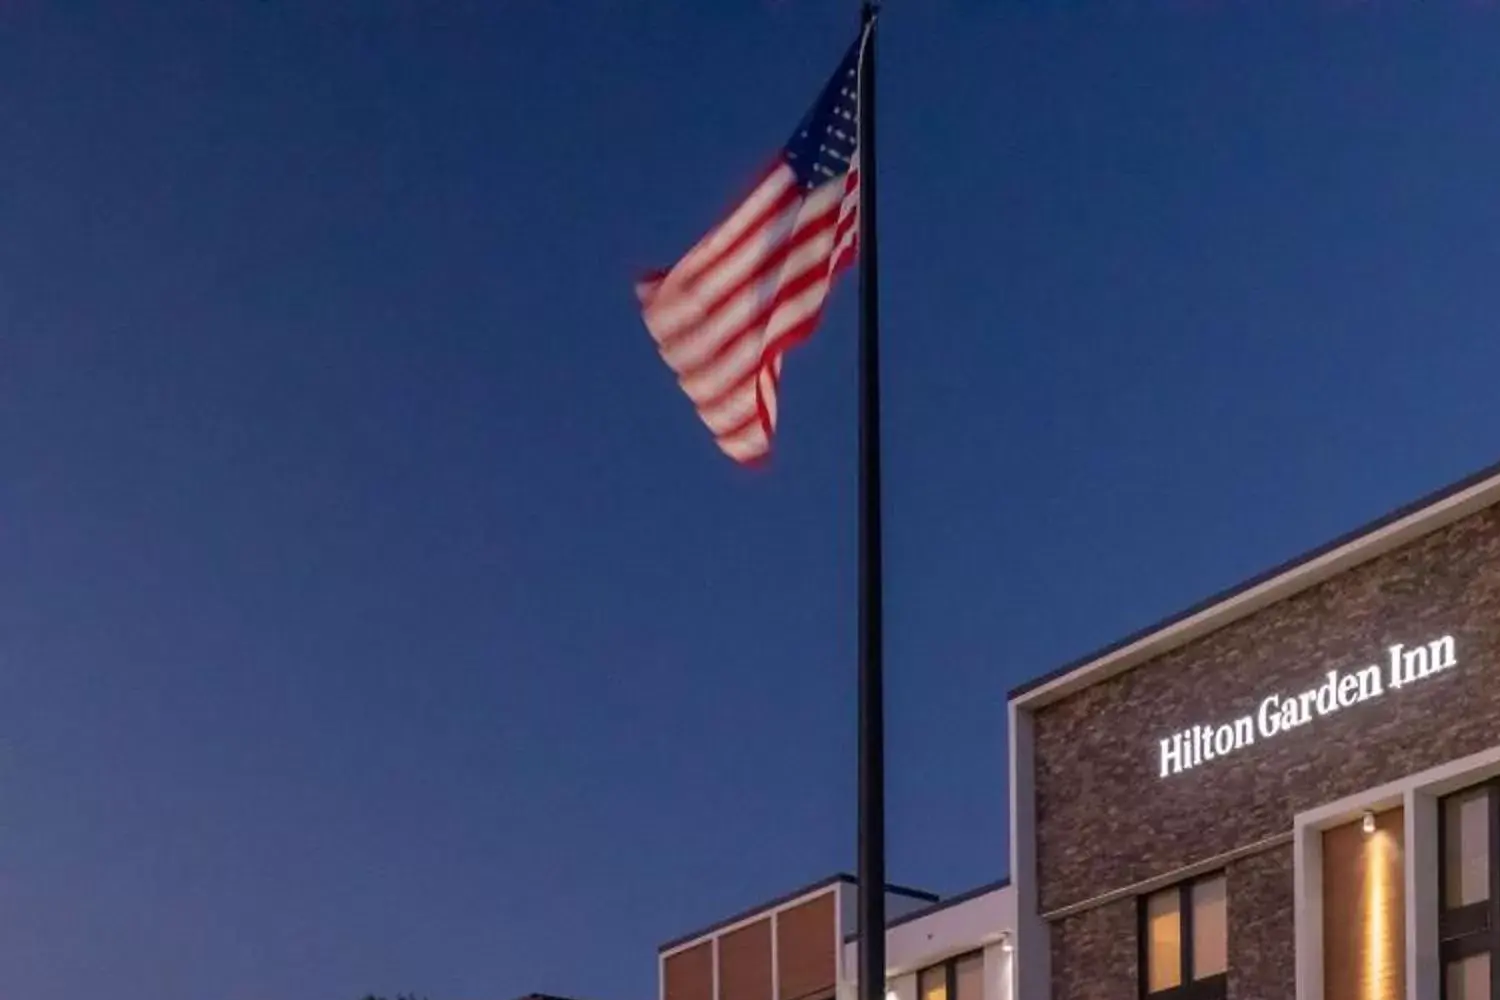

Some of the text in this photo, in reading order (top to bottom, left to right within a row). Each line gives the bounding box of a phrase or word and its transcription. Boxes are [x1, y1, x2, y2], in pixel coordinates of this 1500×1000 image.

[1159, 635, 1457, 778] Hilton Garden Inn
